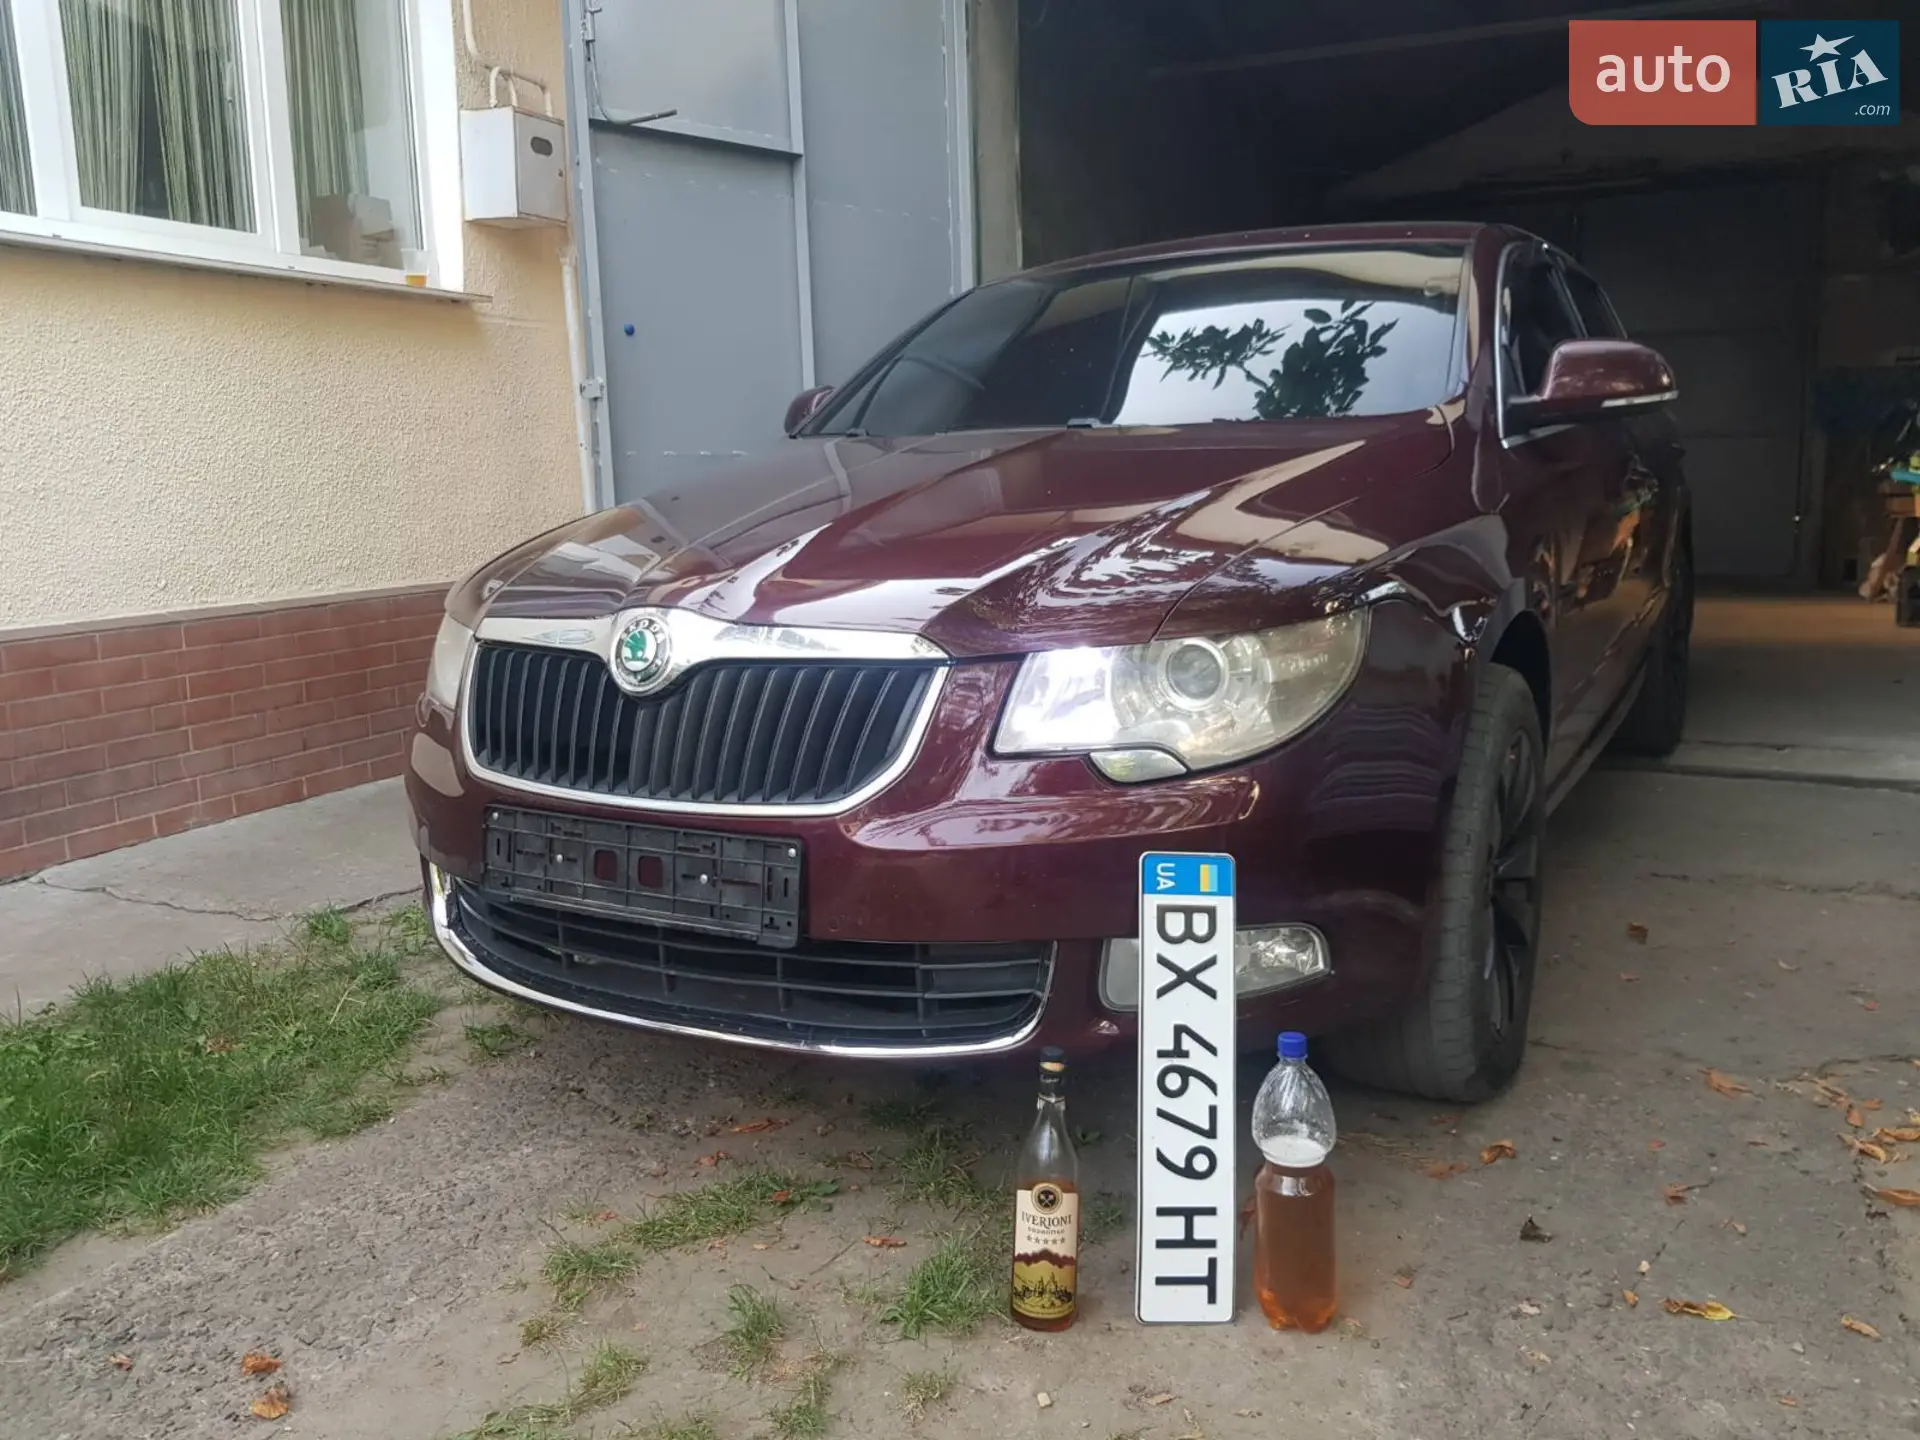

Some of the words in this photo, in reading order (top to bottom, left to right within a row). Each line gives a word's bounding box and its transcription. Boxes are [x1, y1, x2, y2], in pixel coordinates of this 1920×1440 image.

[1156, 863, 1176, 891] UA
[1156, 904, 1218, 1000] BX
[1156, 1023, 1218, 1181] 4679
[1155, 1206, 1218, 1305] HT
